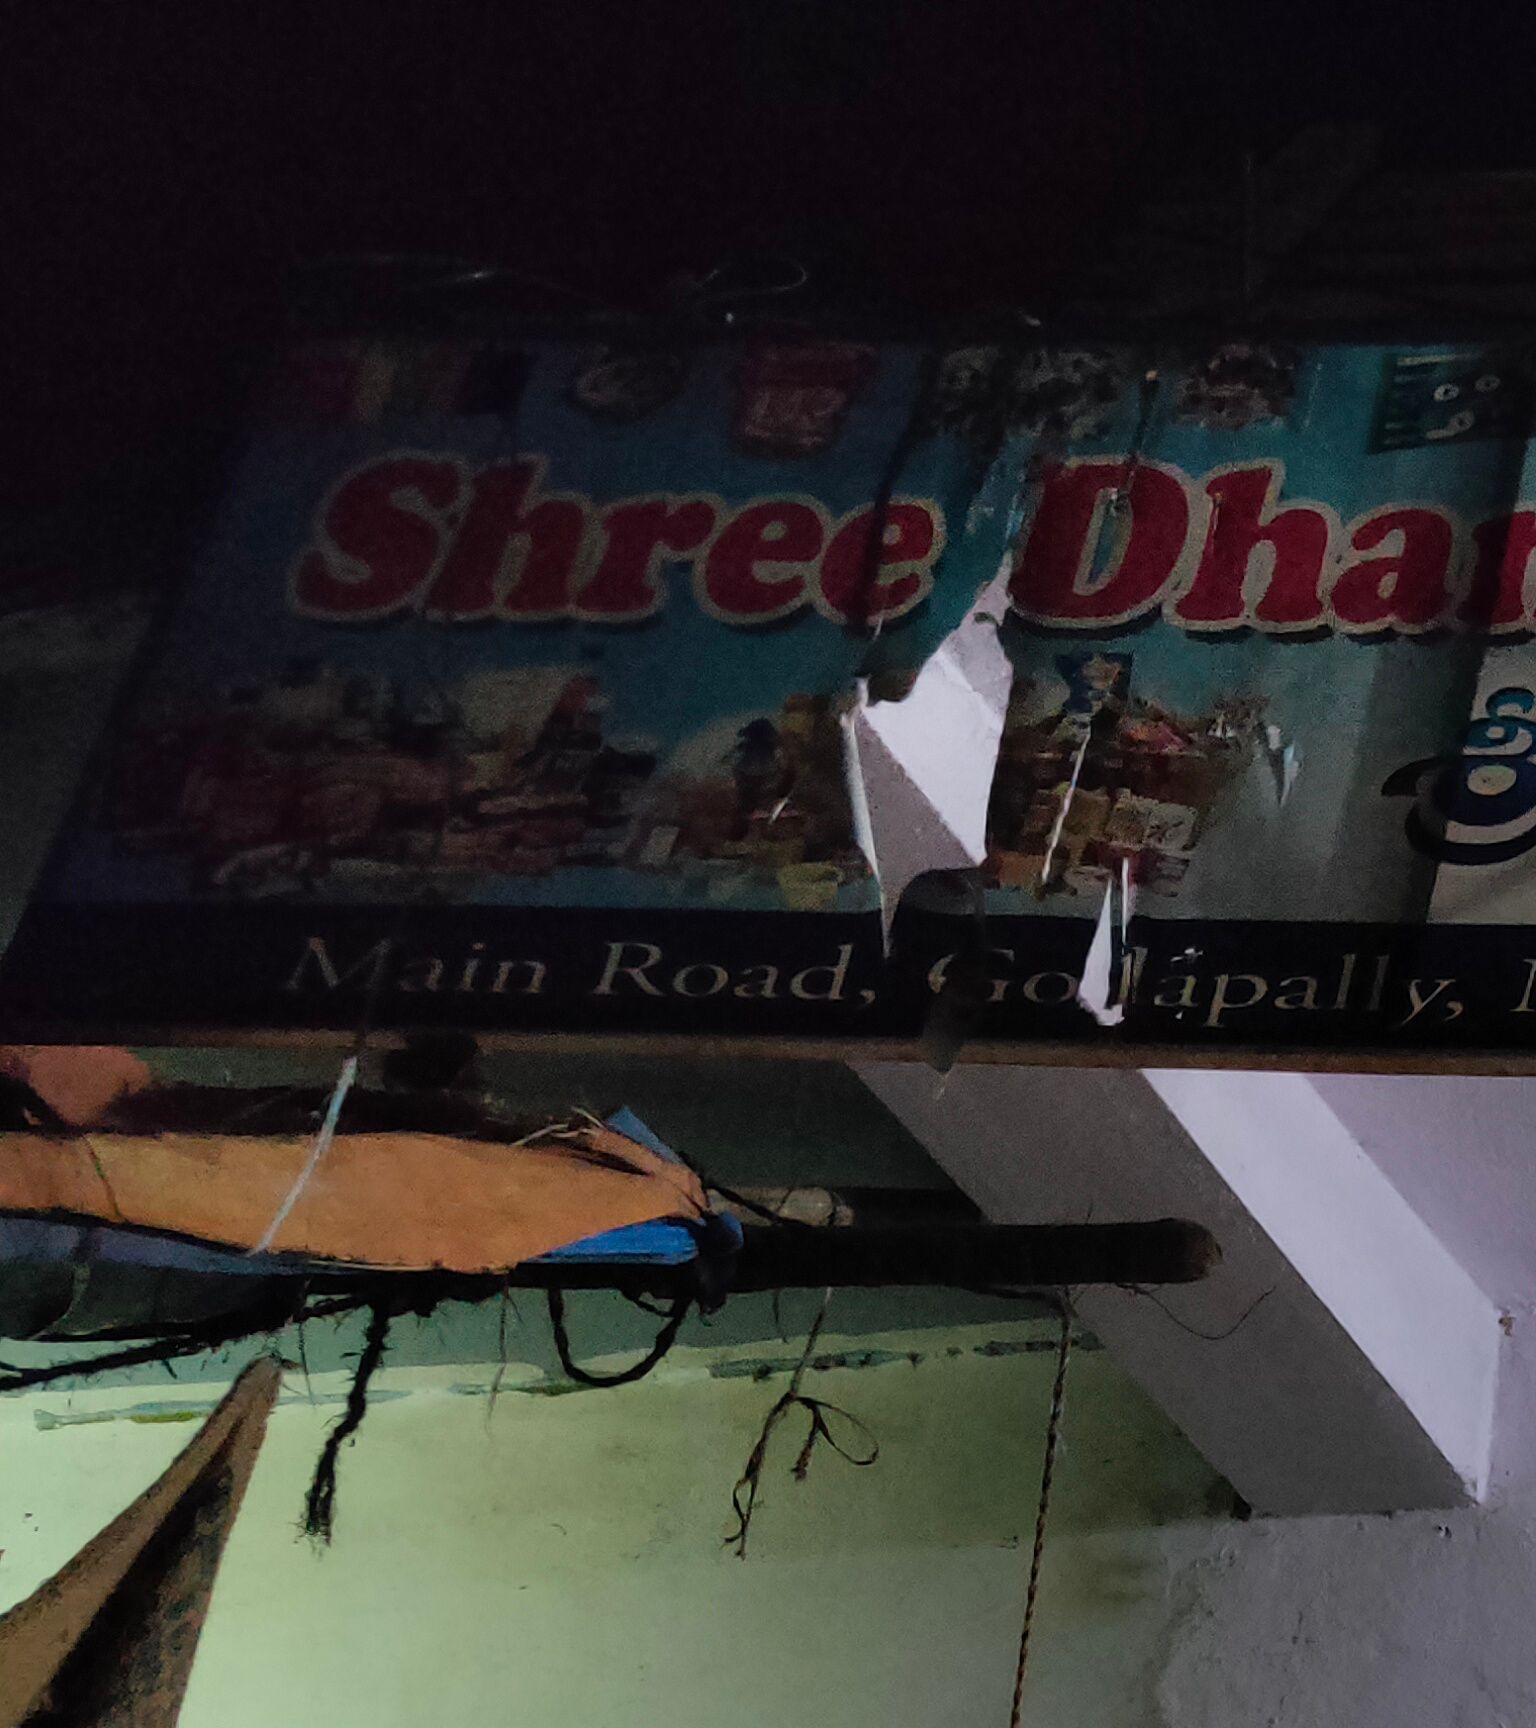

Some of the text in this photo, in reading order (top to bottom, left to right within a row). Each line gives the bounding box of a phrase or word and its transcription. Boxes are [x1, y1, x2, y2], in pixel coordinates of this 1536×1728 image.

[290, 450, 940, 622] Shree
[286, 935, 544, 996] Main
[592, 938, 878, 1008] Road,
[925, 944, 1467, 1026] Golapally,
